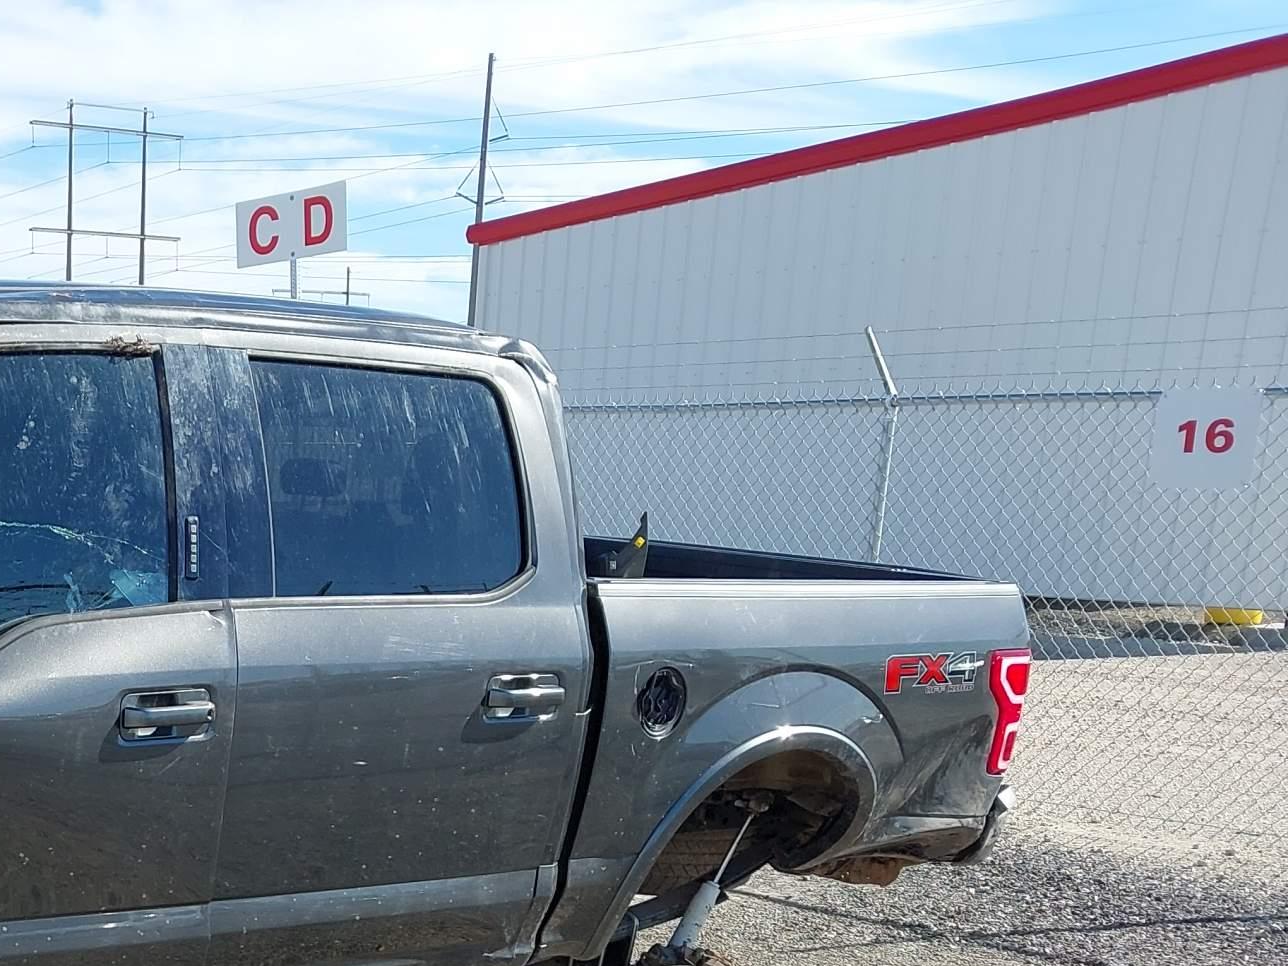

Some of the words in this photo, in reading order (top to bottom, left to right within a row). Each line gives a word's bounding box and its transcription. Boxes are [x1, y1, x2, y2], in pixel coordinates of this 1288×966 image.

[248, 205, 280, 256] C
[303, 195, 334, 246] D
[1177, 417, 1235, 454] 16
[883, 650, 977, 695] FX4
